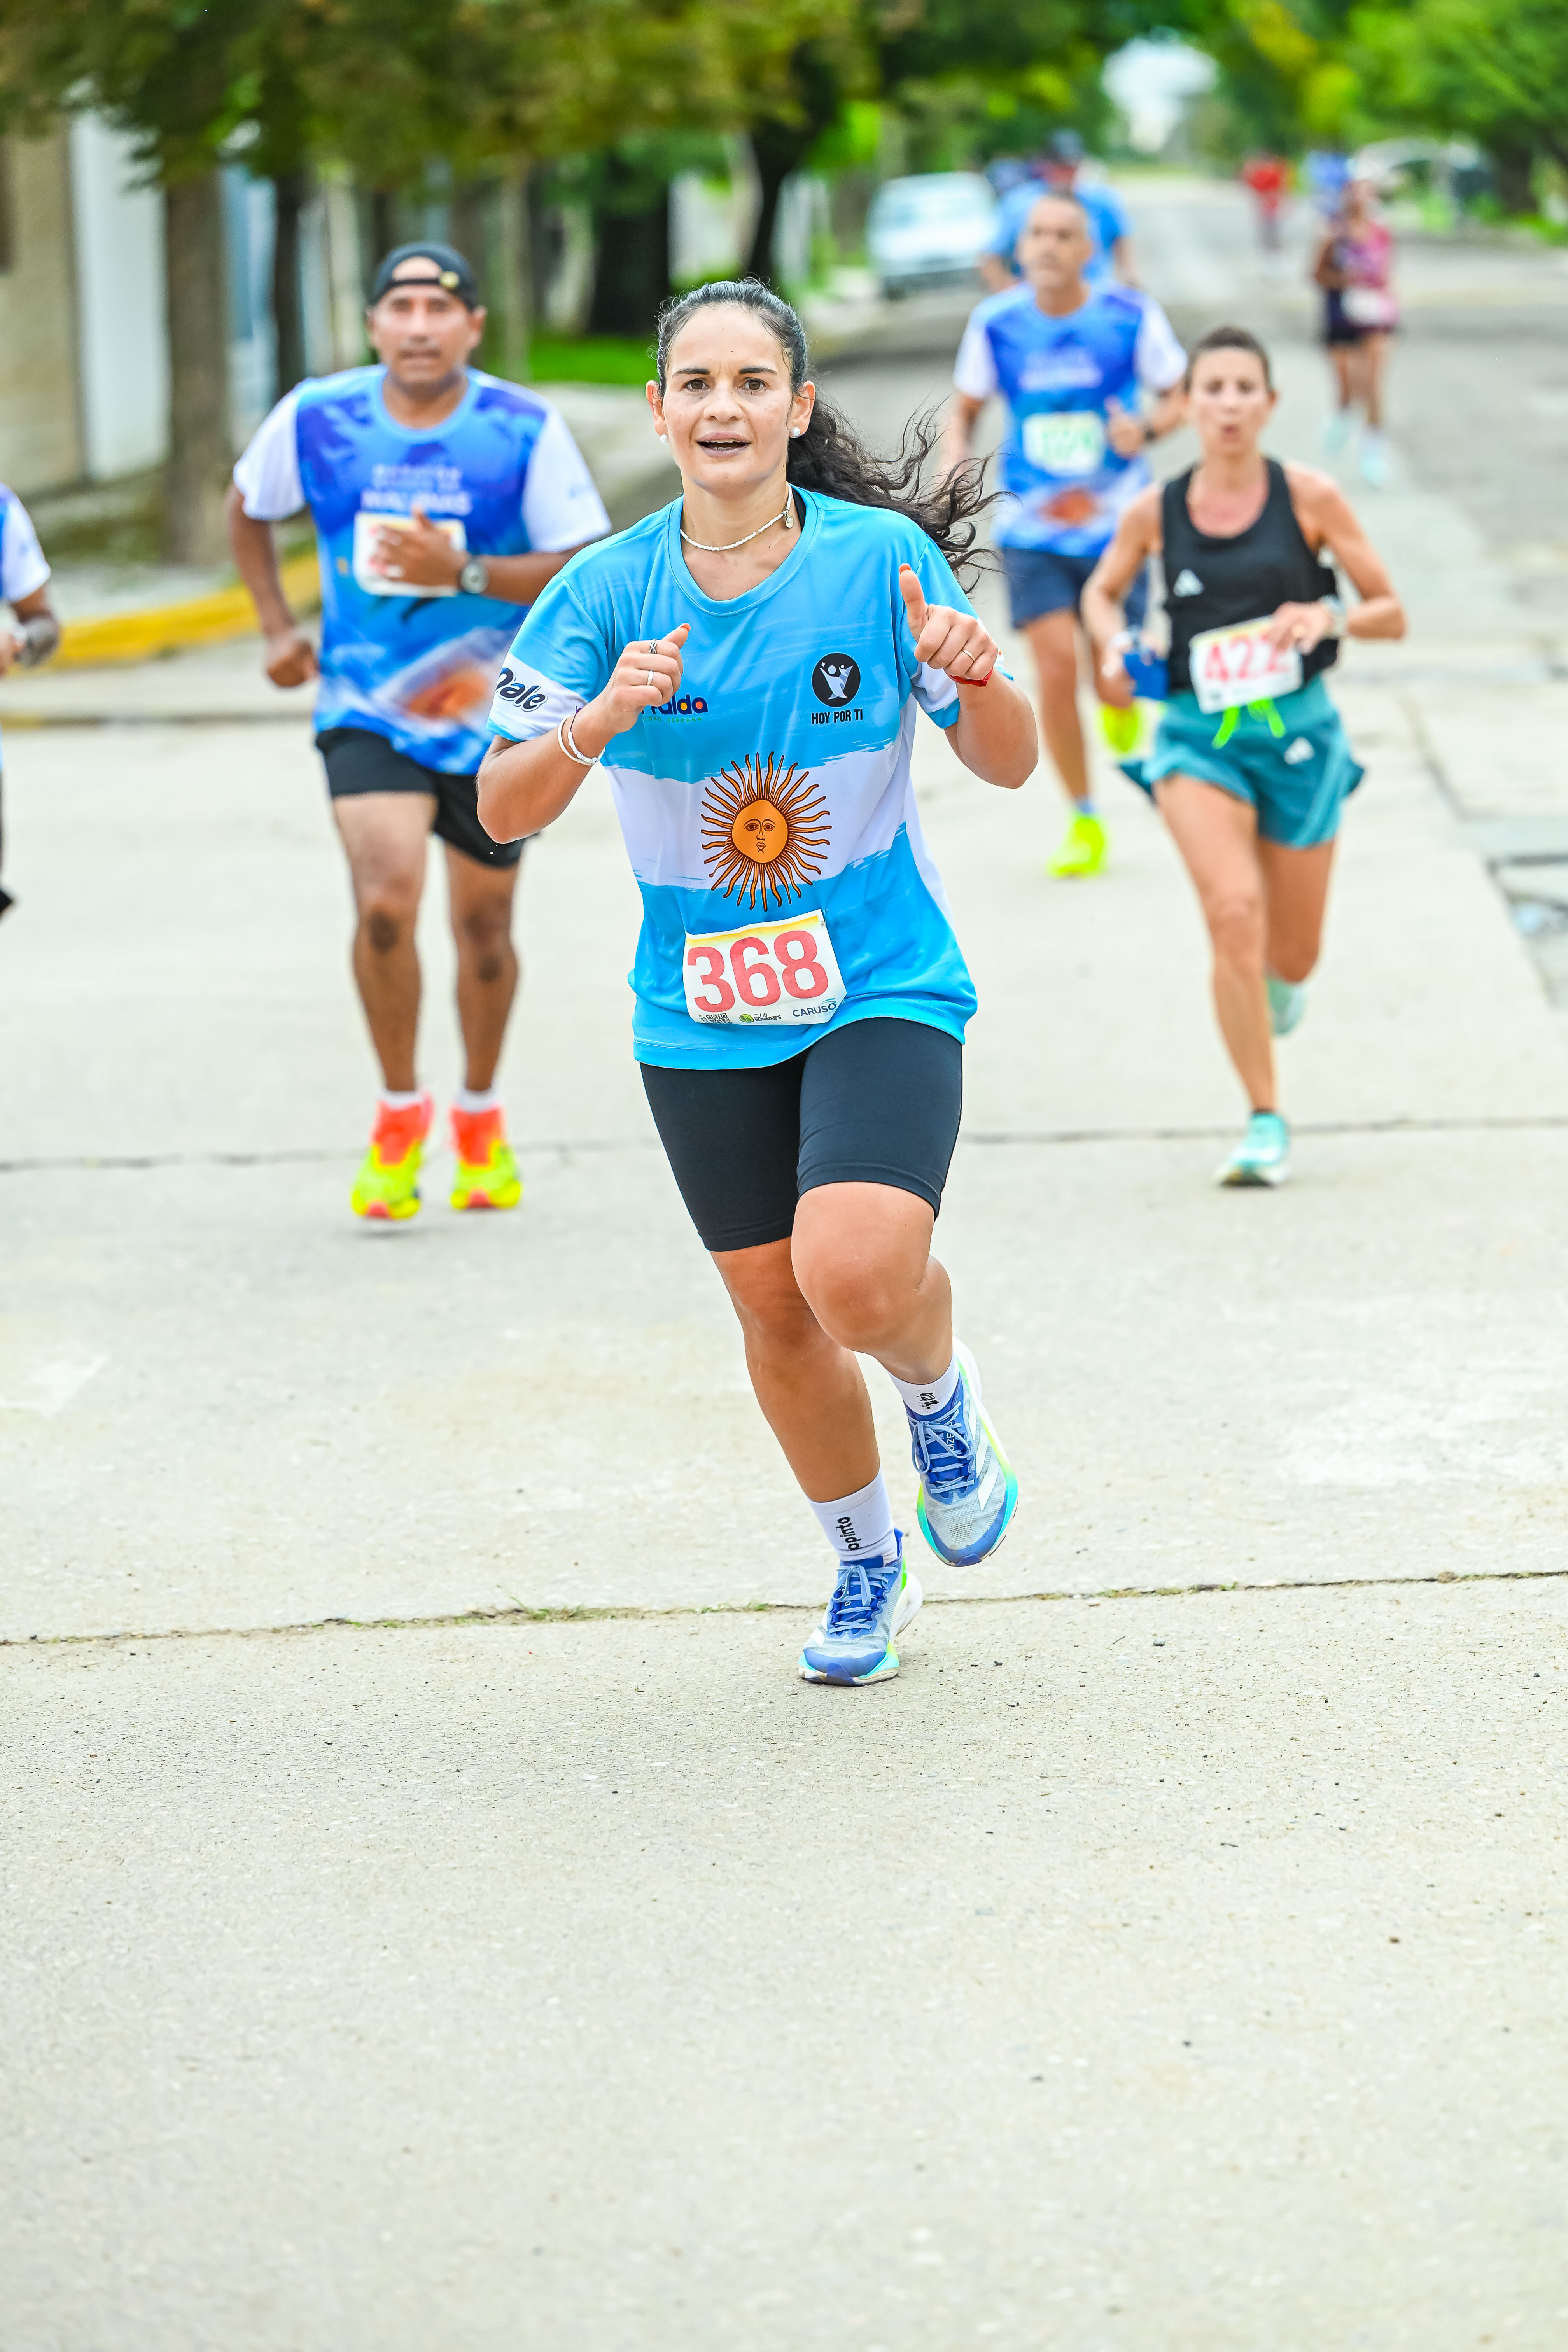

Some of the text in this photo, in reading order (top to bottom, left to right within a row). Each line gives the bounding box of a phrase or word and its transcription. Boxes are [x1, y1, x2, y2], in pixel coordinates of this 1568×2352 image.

[812, 709, 863, 724] HOY POR TI
[687, 930, 828, 1012] 368
[793, 1003, 836, 1017] CARUSO
